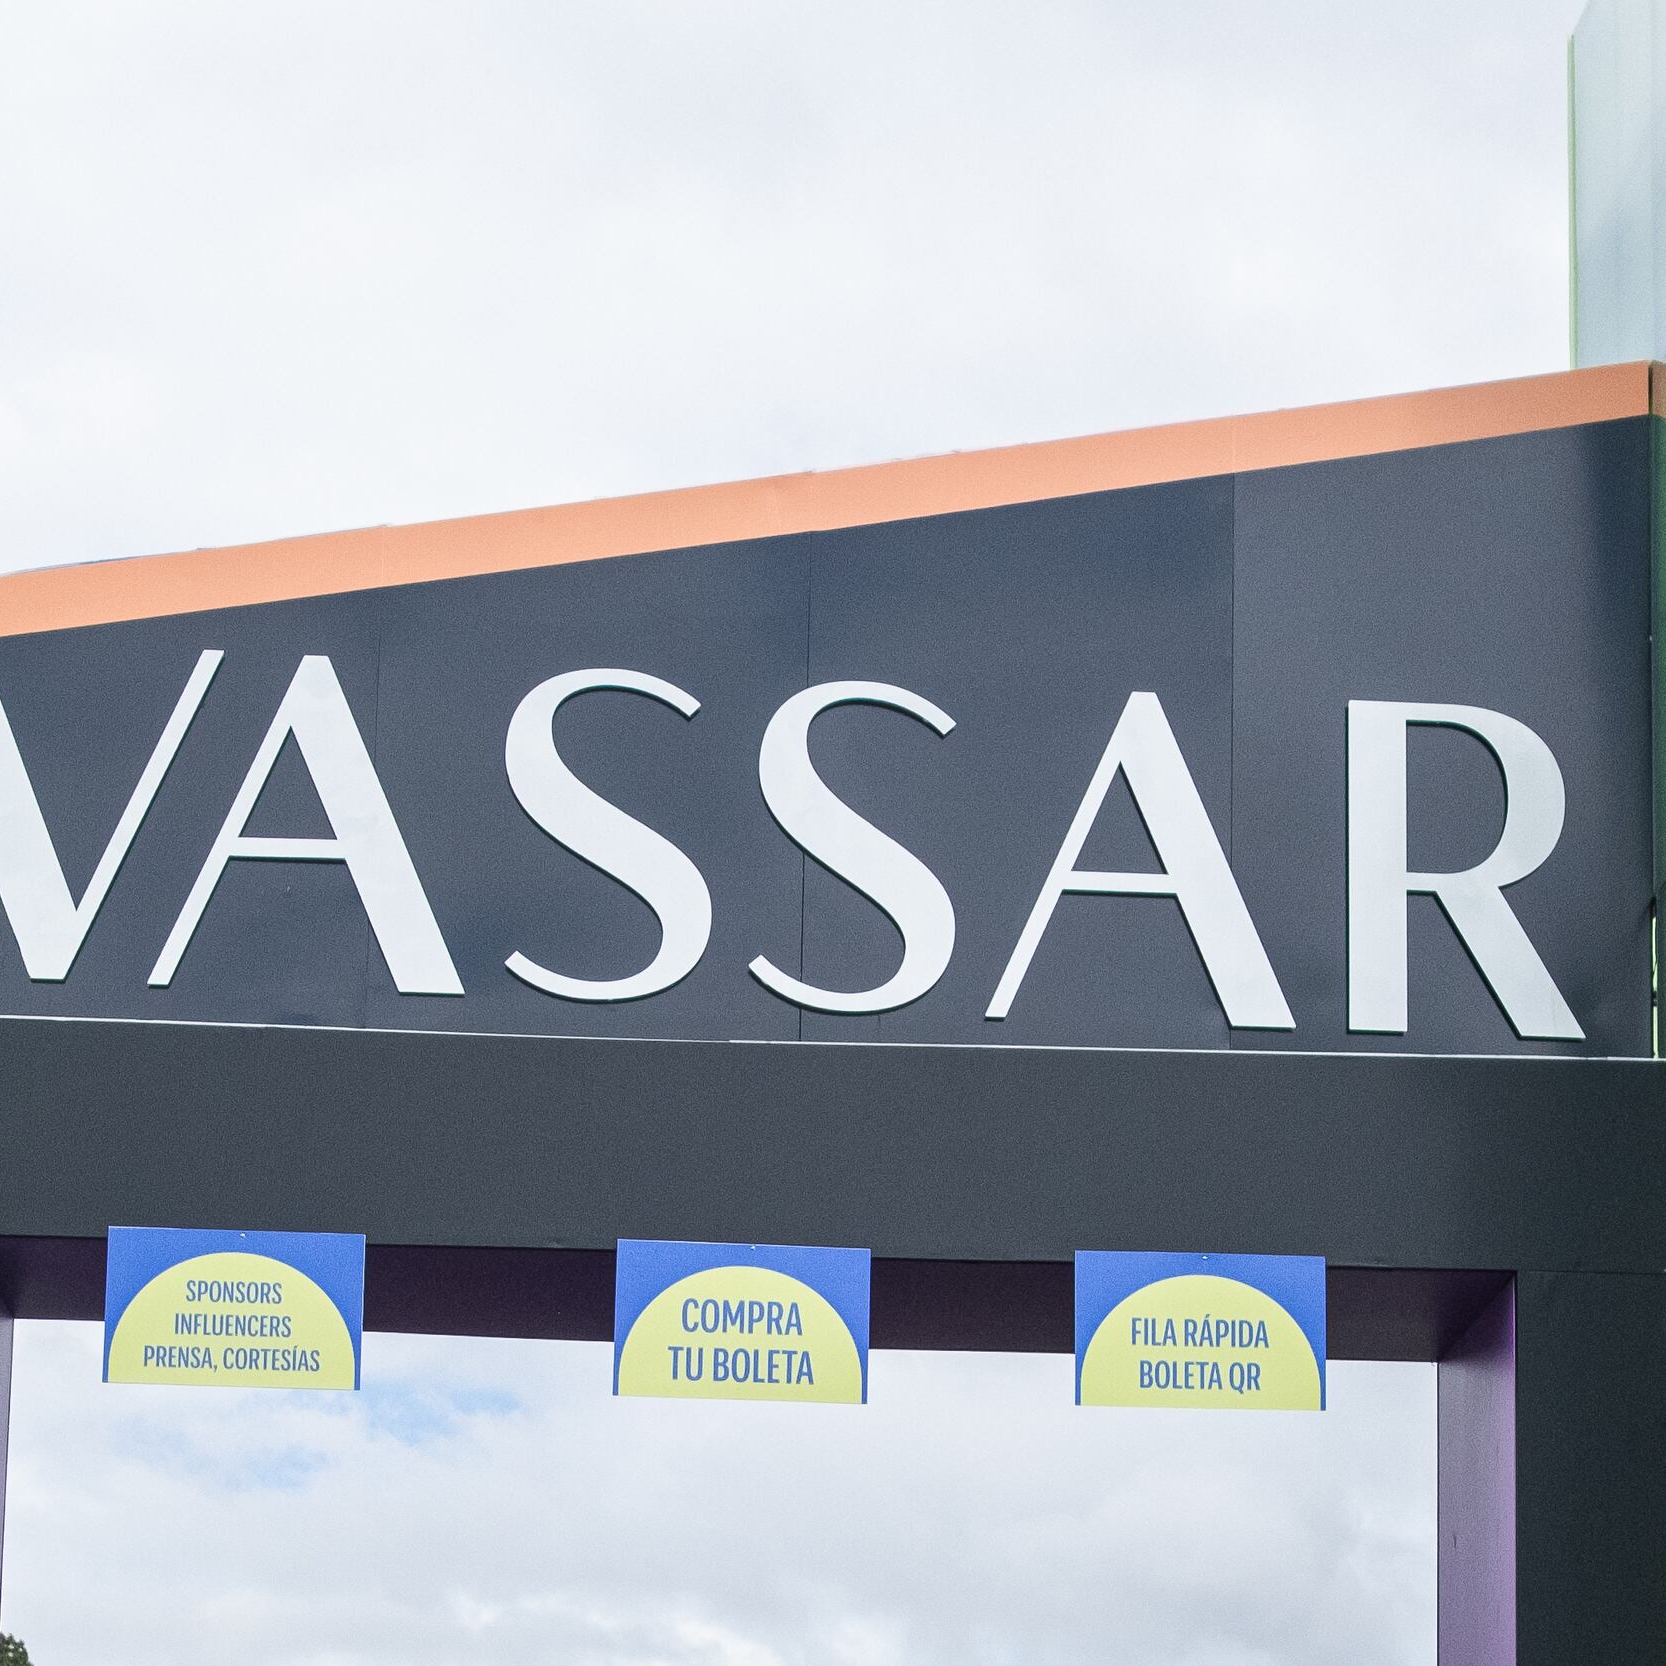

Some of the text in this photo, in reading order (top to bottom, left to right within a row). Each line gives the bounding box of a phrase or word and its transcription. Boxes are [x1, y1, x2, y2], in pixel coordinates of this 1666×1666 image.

[185, 1280, 282, 1305] SPONSORS
[174, 1312, 292, 1338] INFLUENCERS
[681, 1298, 803, 1336] COMPRA
[1131, 1313, 1270, 1349] FILA RÁPIDA
[143, 1345, 321, 1373] PRENSA, CORTESÍAS
[667, 1346, 815, 1385] TU BOLETA
[1139, 1359, 1261, 1395] BOLETA QR
